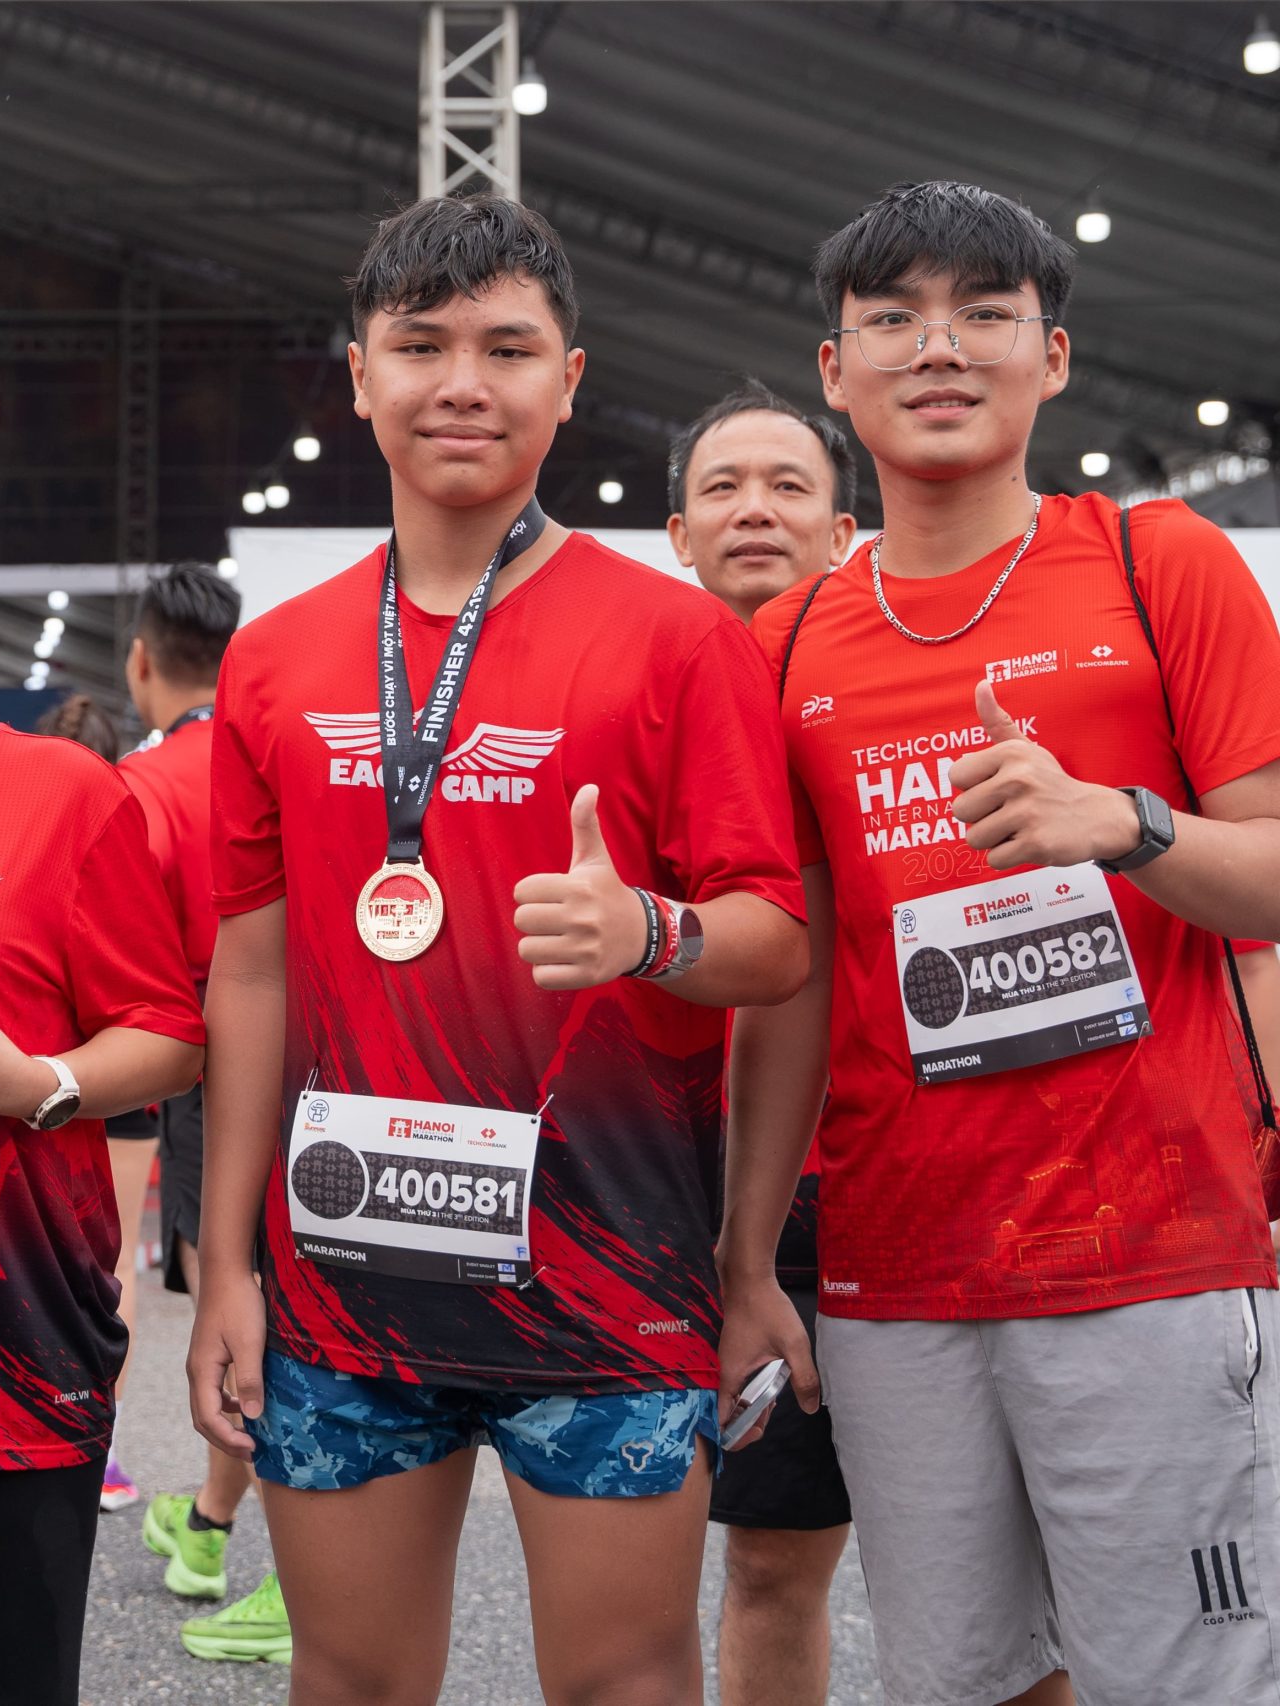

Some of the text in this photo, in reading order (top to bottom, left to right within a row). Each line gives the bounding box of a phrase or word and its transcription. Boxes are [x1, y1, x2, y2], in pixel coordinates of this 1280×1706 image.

[508, 520, 527, 540] RỘI
[383, 631, 396, 657] MỘT
[1012, 650, 1057, 668] HANOI
[1076, 660, 1130, 668] TECHCOMBANK
[1012, 665, 1057, 679] MARATHON
[385, 674, 397, 708] CHẠY
[422, 642, 468, 743] FINISHER
[812, 716, 836, 727] SPORT
[852, 716, 1038, 767] TECHCOMBK
[441, 775, 536, 804] CAMP
[855, 753, 977, 814] HAN
[862, 801, 954, 831] INTERNA
[864, 817, 968, 857] MARAT
[986, 892, 1031, 912] HANOI
[989, 906, 1034, 921] MARATHON
[970, 925, 1122, 994] 400582
[922, 1054, 982, 1074] MARATHON
[413, 1119, 456, 1134] HANOI
[412, 1133, 454, 1143] MARATHON
[375, 1167, 517, 1218] 400581
[303, 1242, 367, 1262] MARATHON
[638, 1319, 689, 1335] ONWAYS
[54, 1389, 89, 1404] LONG.VN
[1227, 1611, 1255, 1622] Pure
